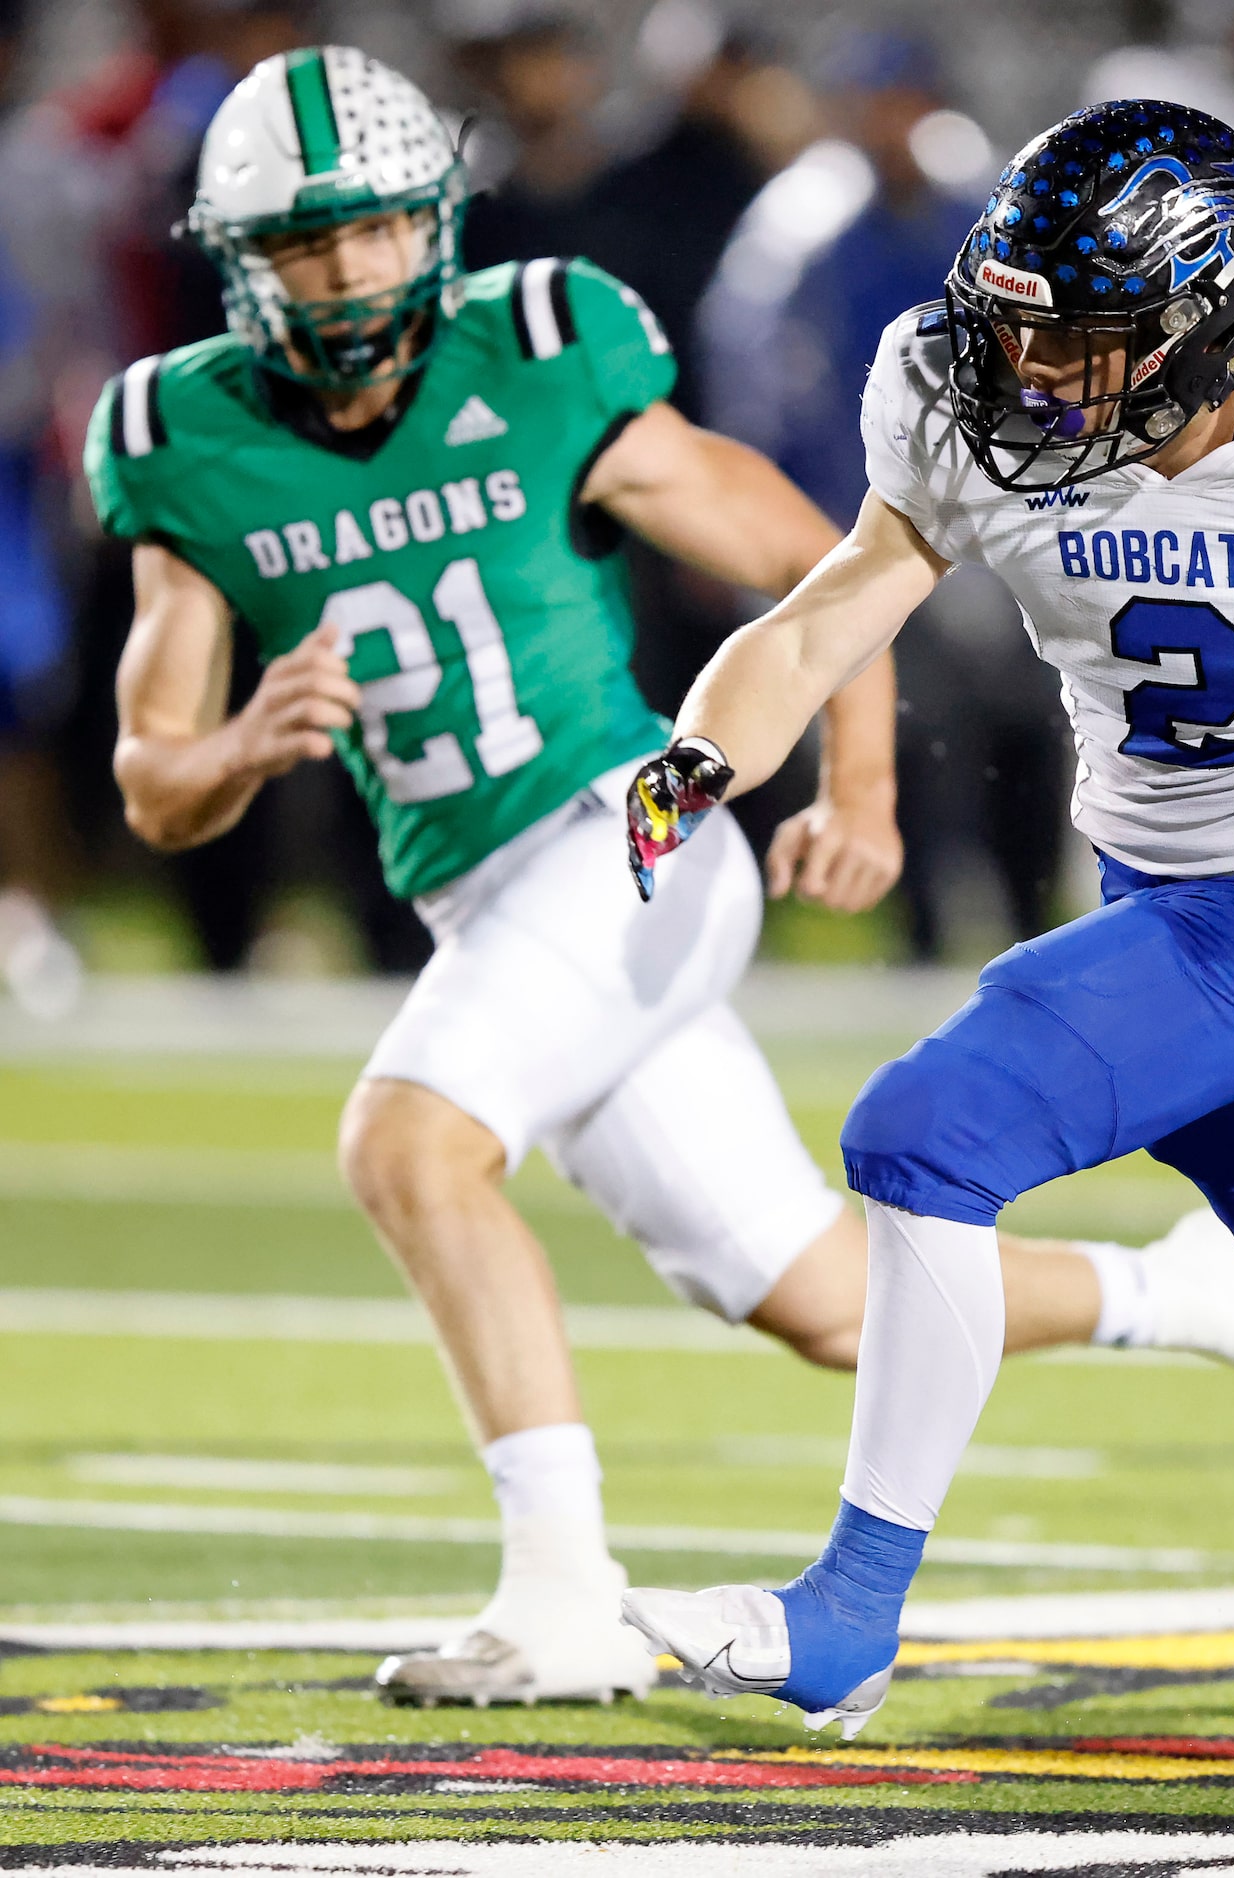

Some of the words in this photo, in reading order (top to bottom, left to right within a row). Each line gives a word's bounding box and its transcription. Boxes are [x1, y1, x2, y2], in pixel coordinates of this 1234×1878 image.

[982, 266, 1038, 297] Riddell
[1132, 350, 1166, 386] iddell
[244, 469, 527, 578] DRAGONS
[316, 557, 544, 805] 21
